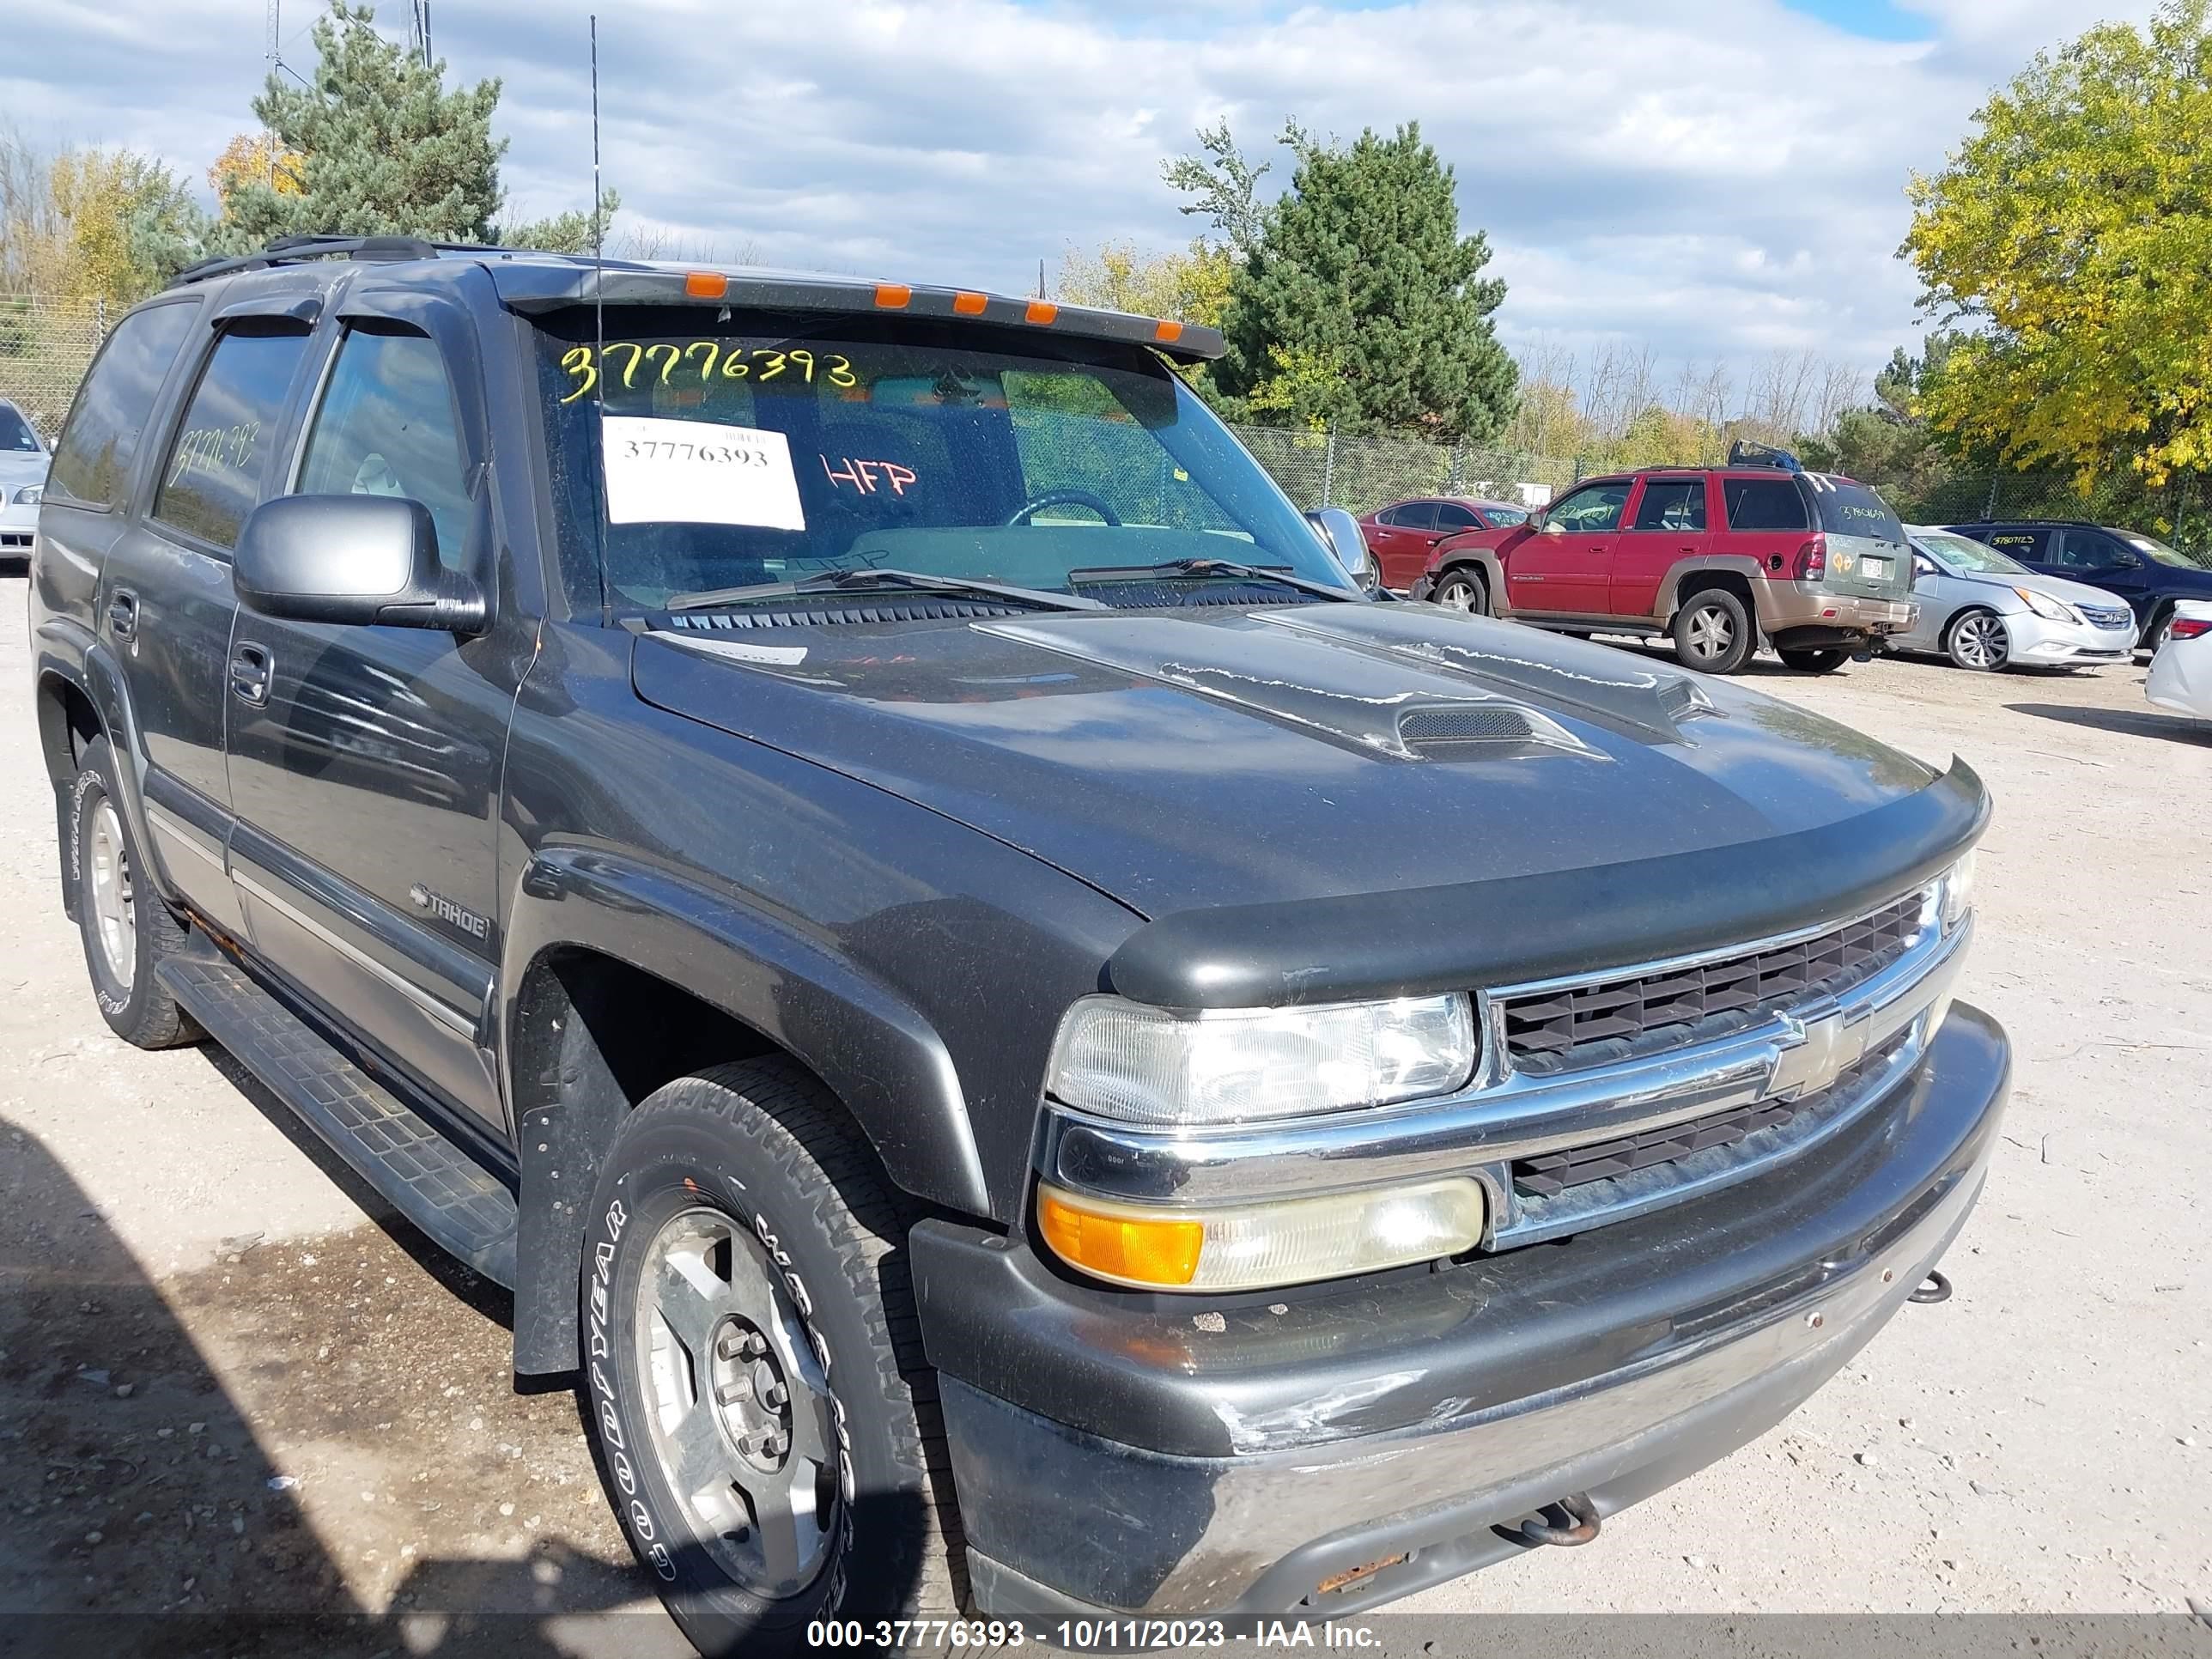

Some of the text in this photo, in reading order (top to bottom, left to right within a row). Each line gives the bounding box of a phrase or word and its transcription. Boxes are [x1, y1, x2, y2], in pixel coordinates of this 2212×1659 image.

[560, 341, 857, 404] 37776393
[624, 441, 768, 467] 37776393
[818, 453, 917, 495] HFP
[1992, 535, 2035, 546] 37807123
[429, 894, 488, 941] TAHOE
[591, 1199, 677, 1583] GOODYEAR
